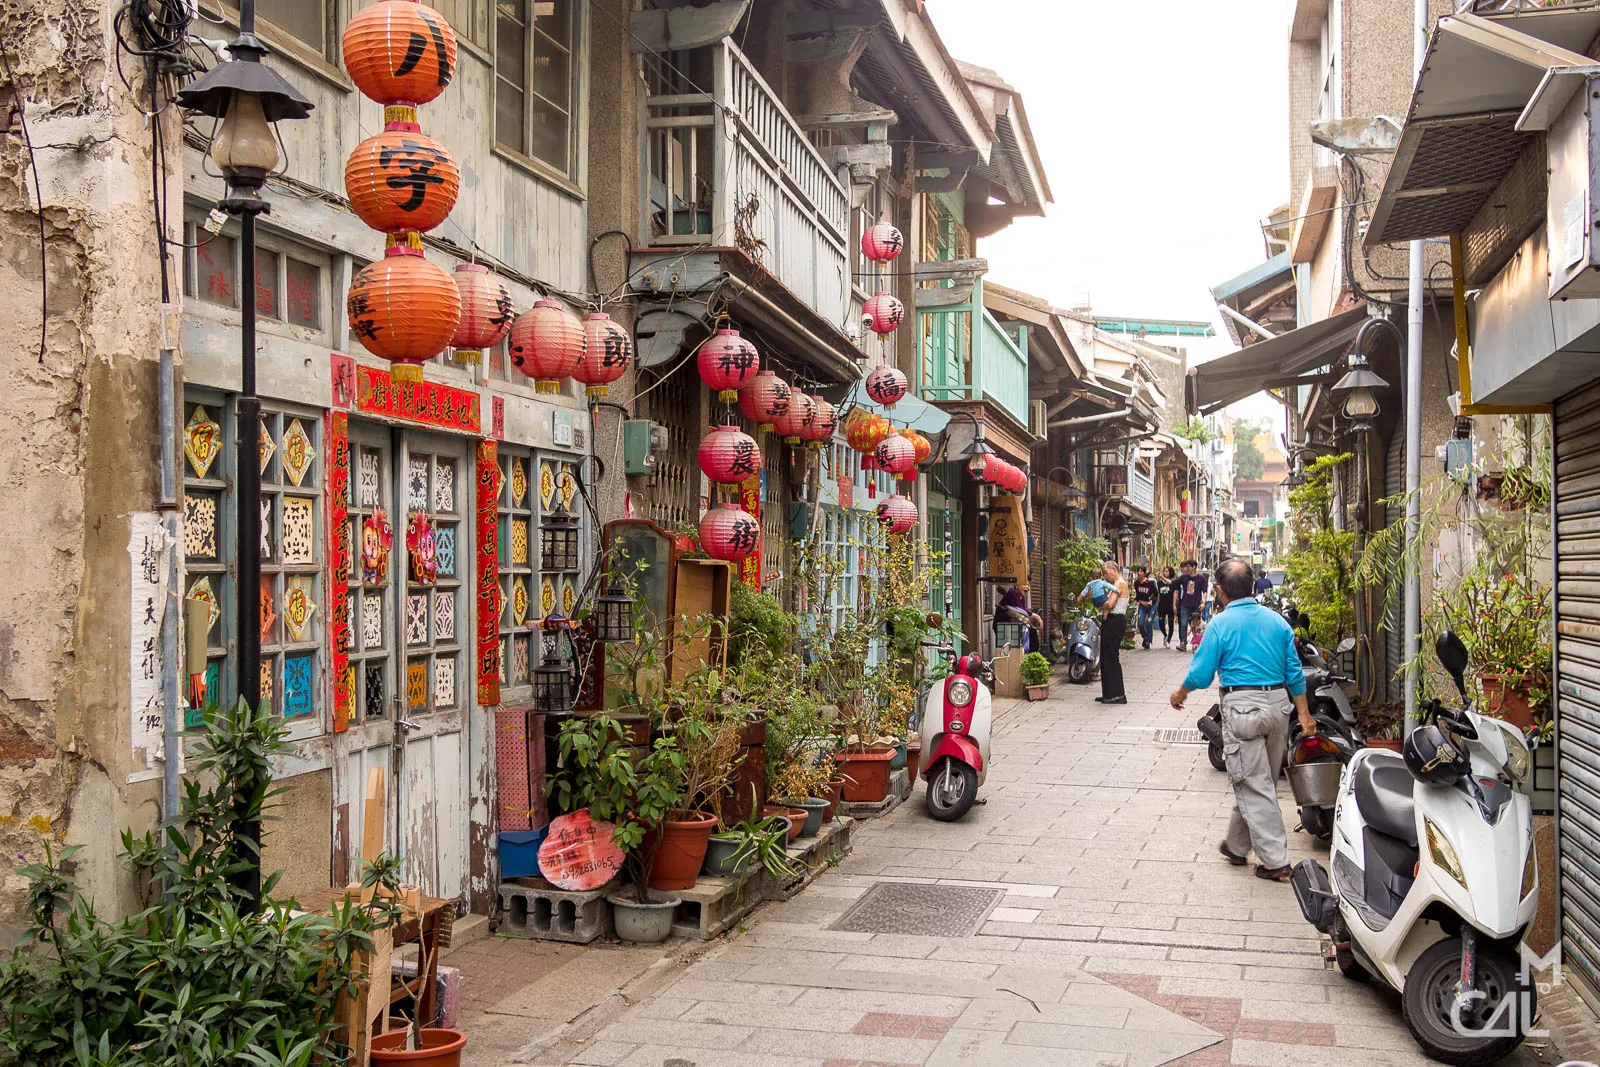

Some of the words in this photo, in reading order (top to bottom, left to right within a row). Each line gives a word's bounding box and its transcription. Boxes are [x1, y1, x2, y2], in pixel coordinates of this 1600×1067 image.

[395, 10, 453, 86] 八
[718, 345, 755, 382] 神
[192, 426, 212, 459] 福
[288, 436, 303, 468] 福
[728, 519, 758, 555] 街
[290, 589, 305, 623] 福
